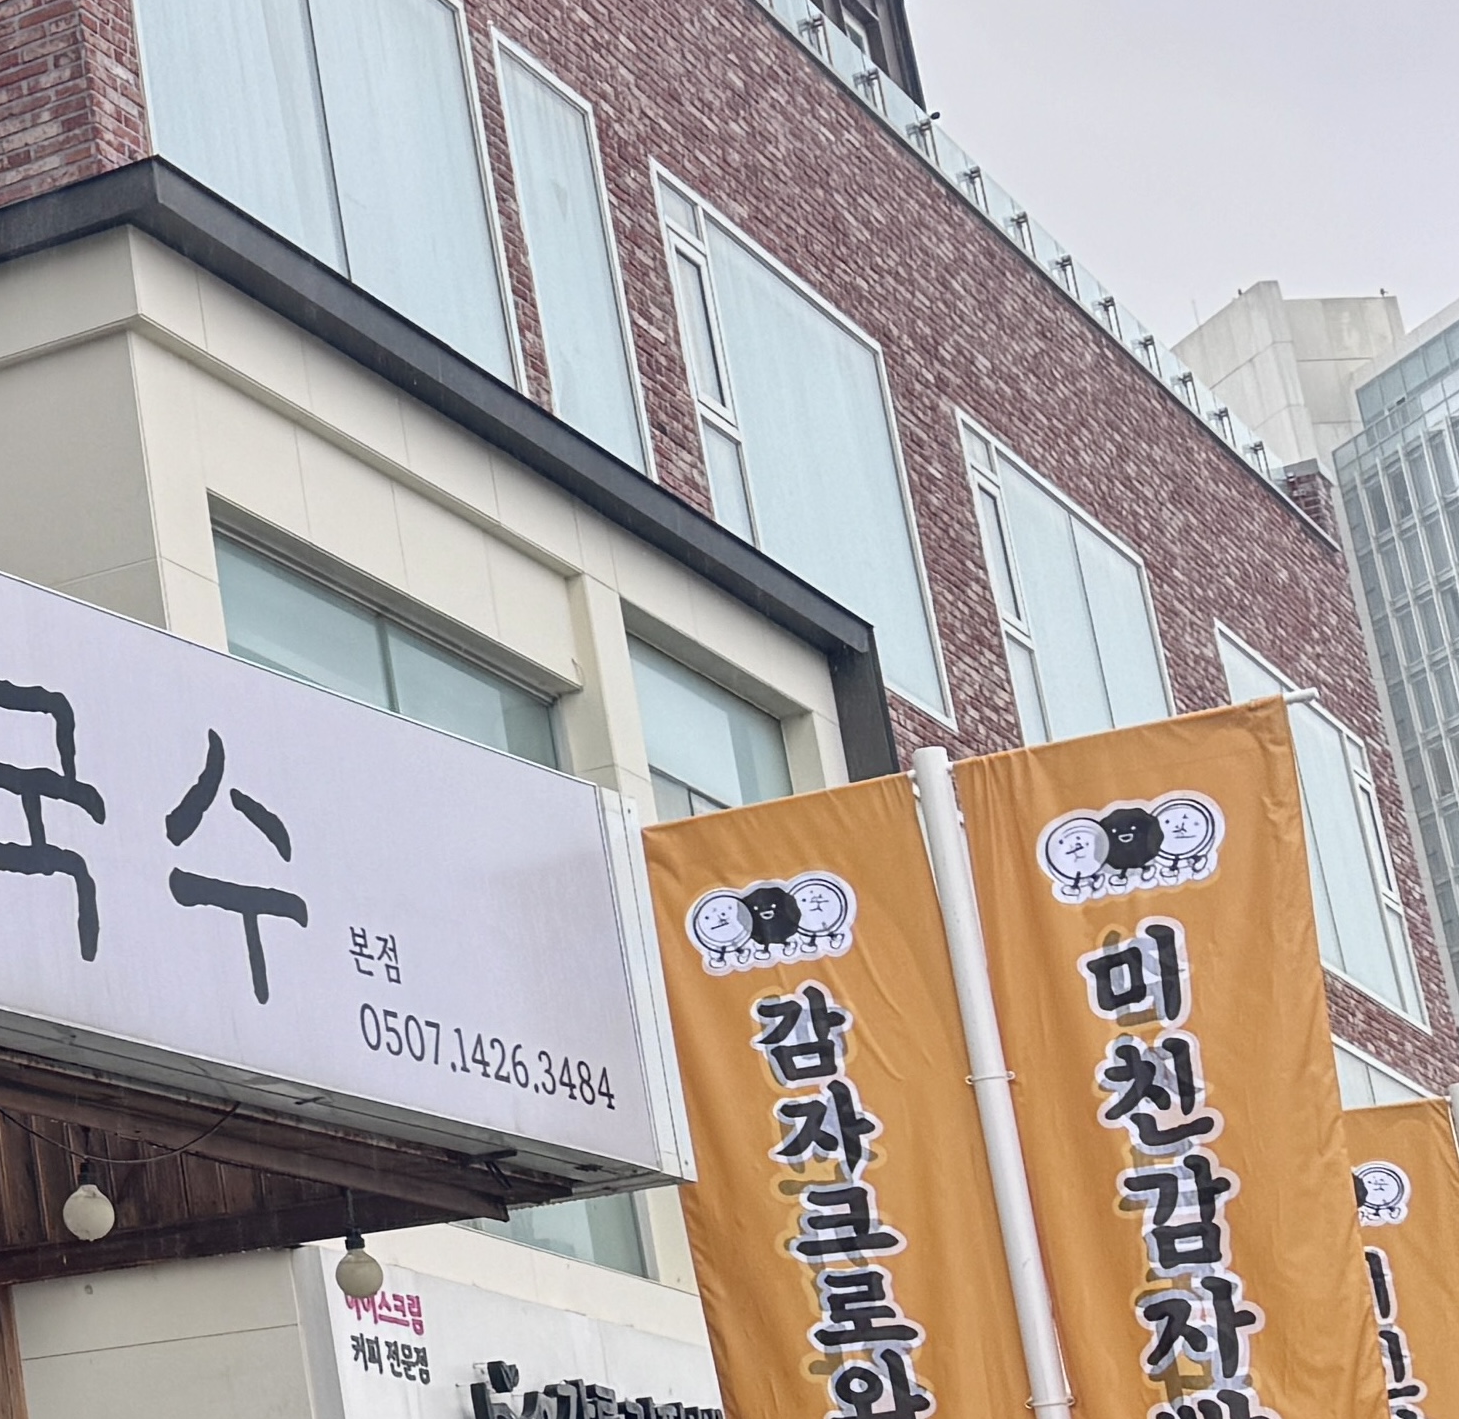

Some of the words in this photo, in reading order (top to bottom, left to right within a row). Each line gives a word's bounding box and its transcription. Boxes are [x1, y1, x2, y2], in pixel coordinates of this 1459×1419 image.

[348, 924, 402, 984] 본점
[360, 1003, 615, 1109] 0507.1426.3484
[351, 1333, 382, 1374] 커피
[385, 1341, 430, 1385] 전문점
